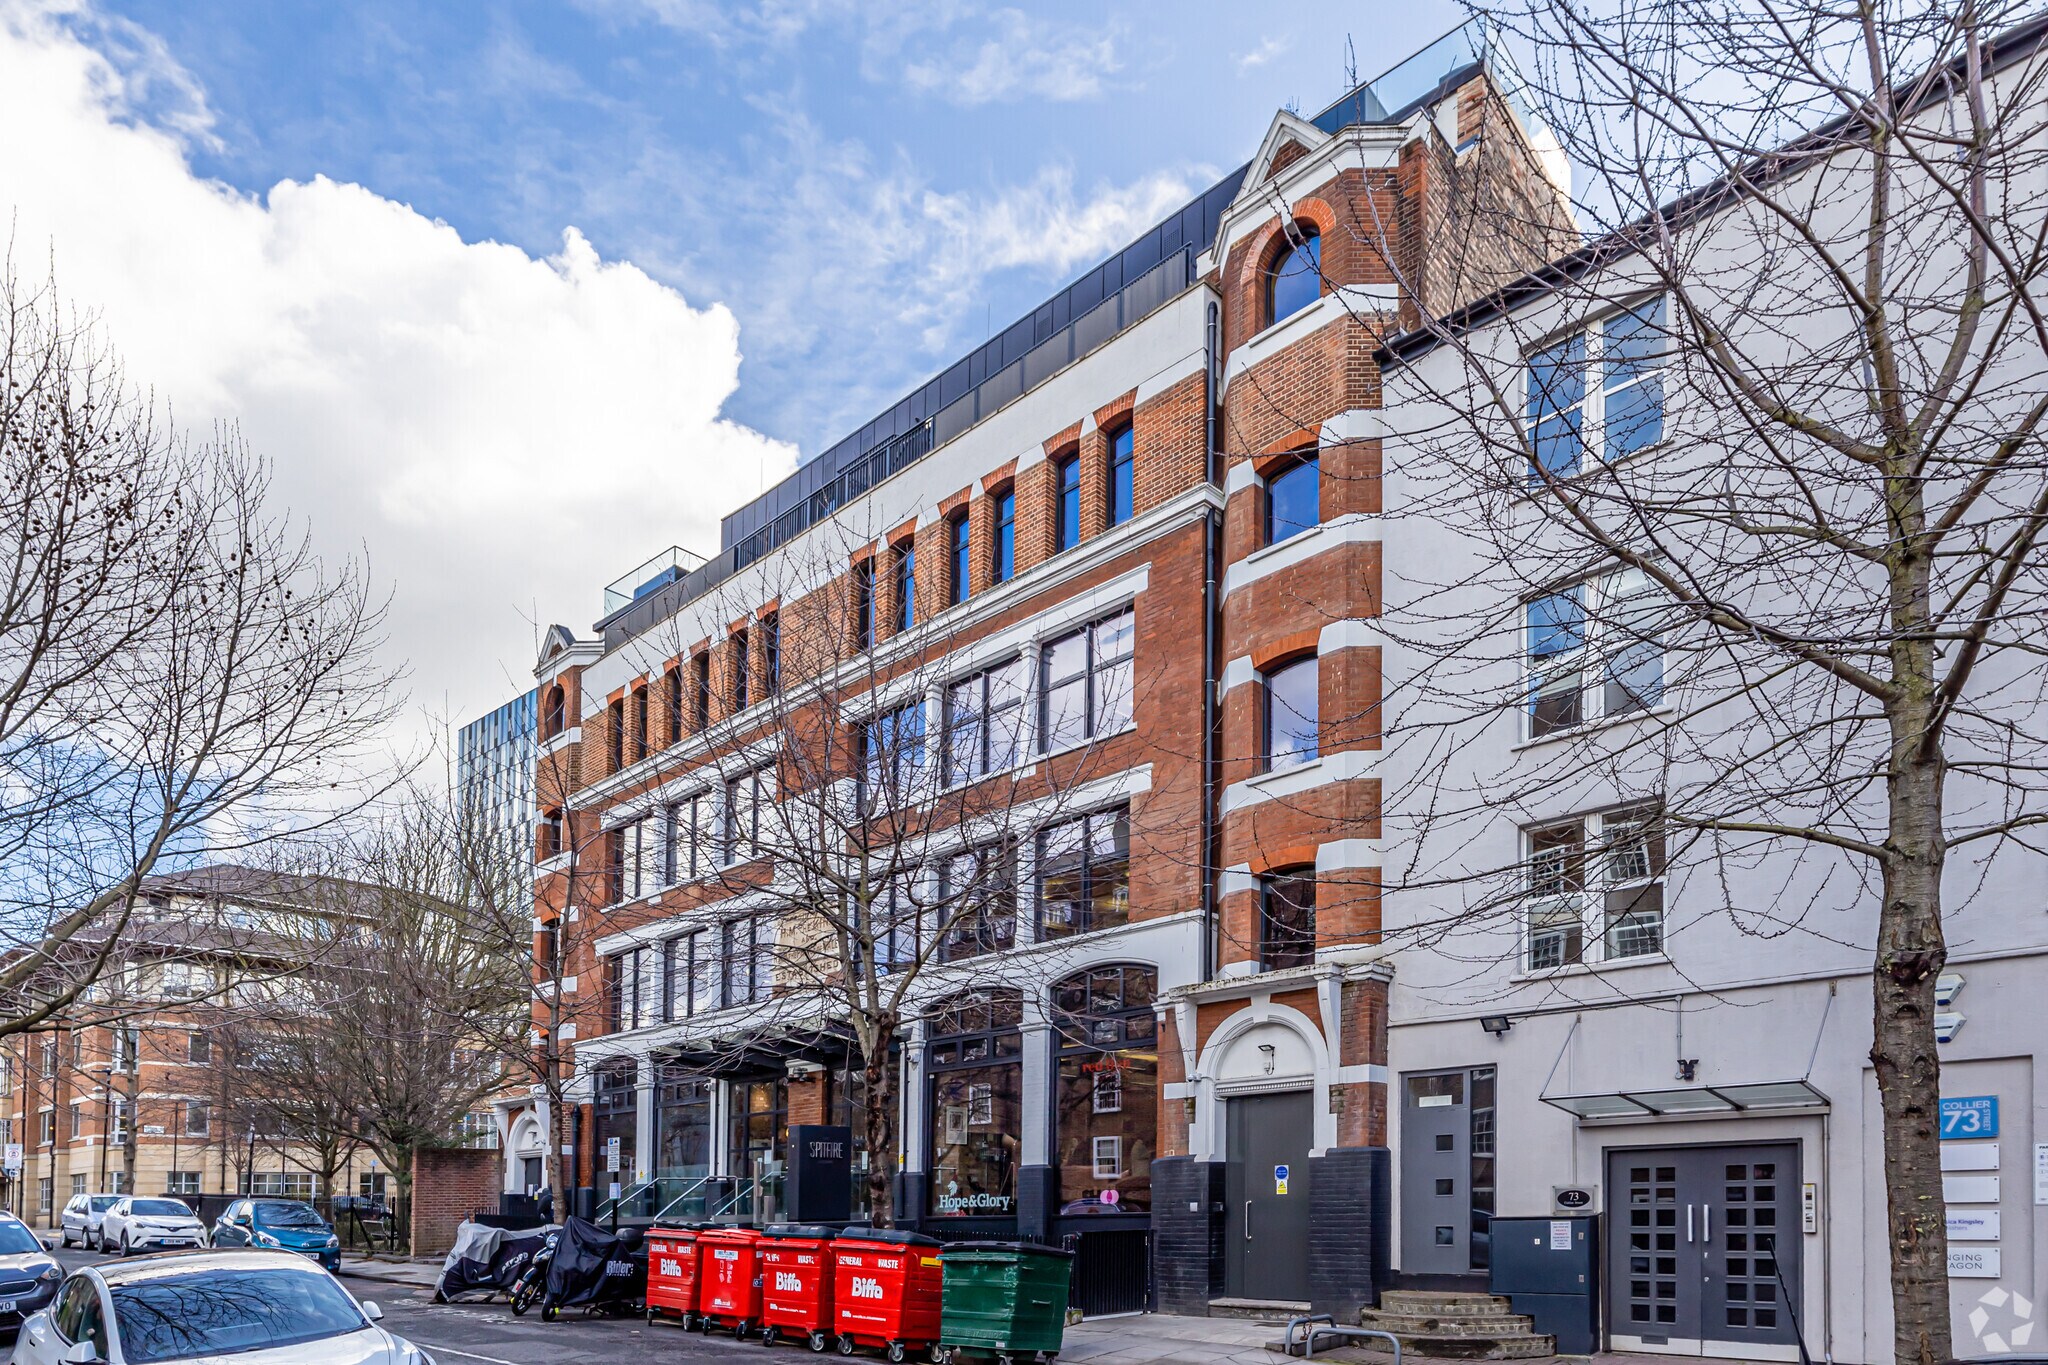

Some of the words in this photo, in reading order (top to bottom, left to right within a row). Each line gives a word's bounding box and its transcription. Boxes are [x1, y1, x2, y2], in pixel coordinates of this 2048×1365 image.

[776, 961, 839, 981] ESTABISHED
[1942, 1100, 1990, 1110] COLLIER
[1943, 1109, 1980, 1133] 73
[1983, 1109, 1991, 1131] STREET
[810, 1141, 843, 1159] SPITFIRE
[939, 1193, 1010, 1211] Hope&Glory
[1568, 1192, 1579, 1201] 73
[1957, 1218, 1985, 1226] Kingsley
[660, 1258, 682, 1277] Biffa
[838, 1255, 863, 1267] GENERAL
[877, 1258, 899, 1269] WASTE
[776, 1271, 802, 1292] Biffa
[851, 1277, 883, 1299] Biffa
